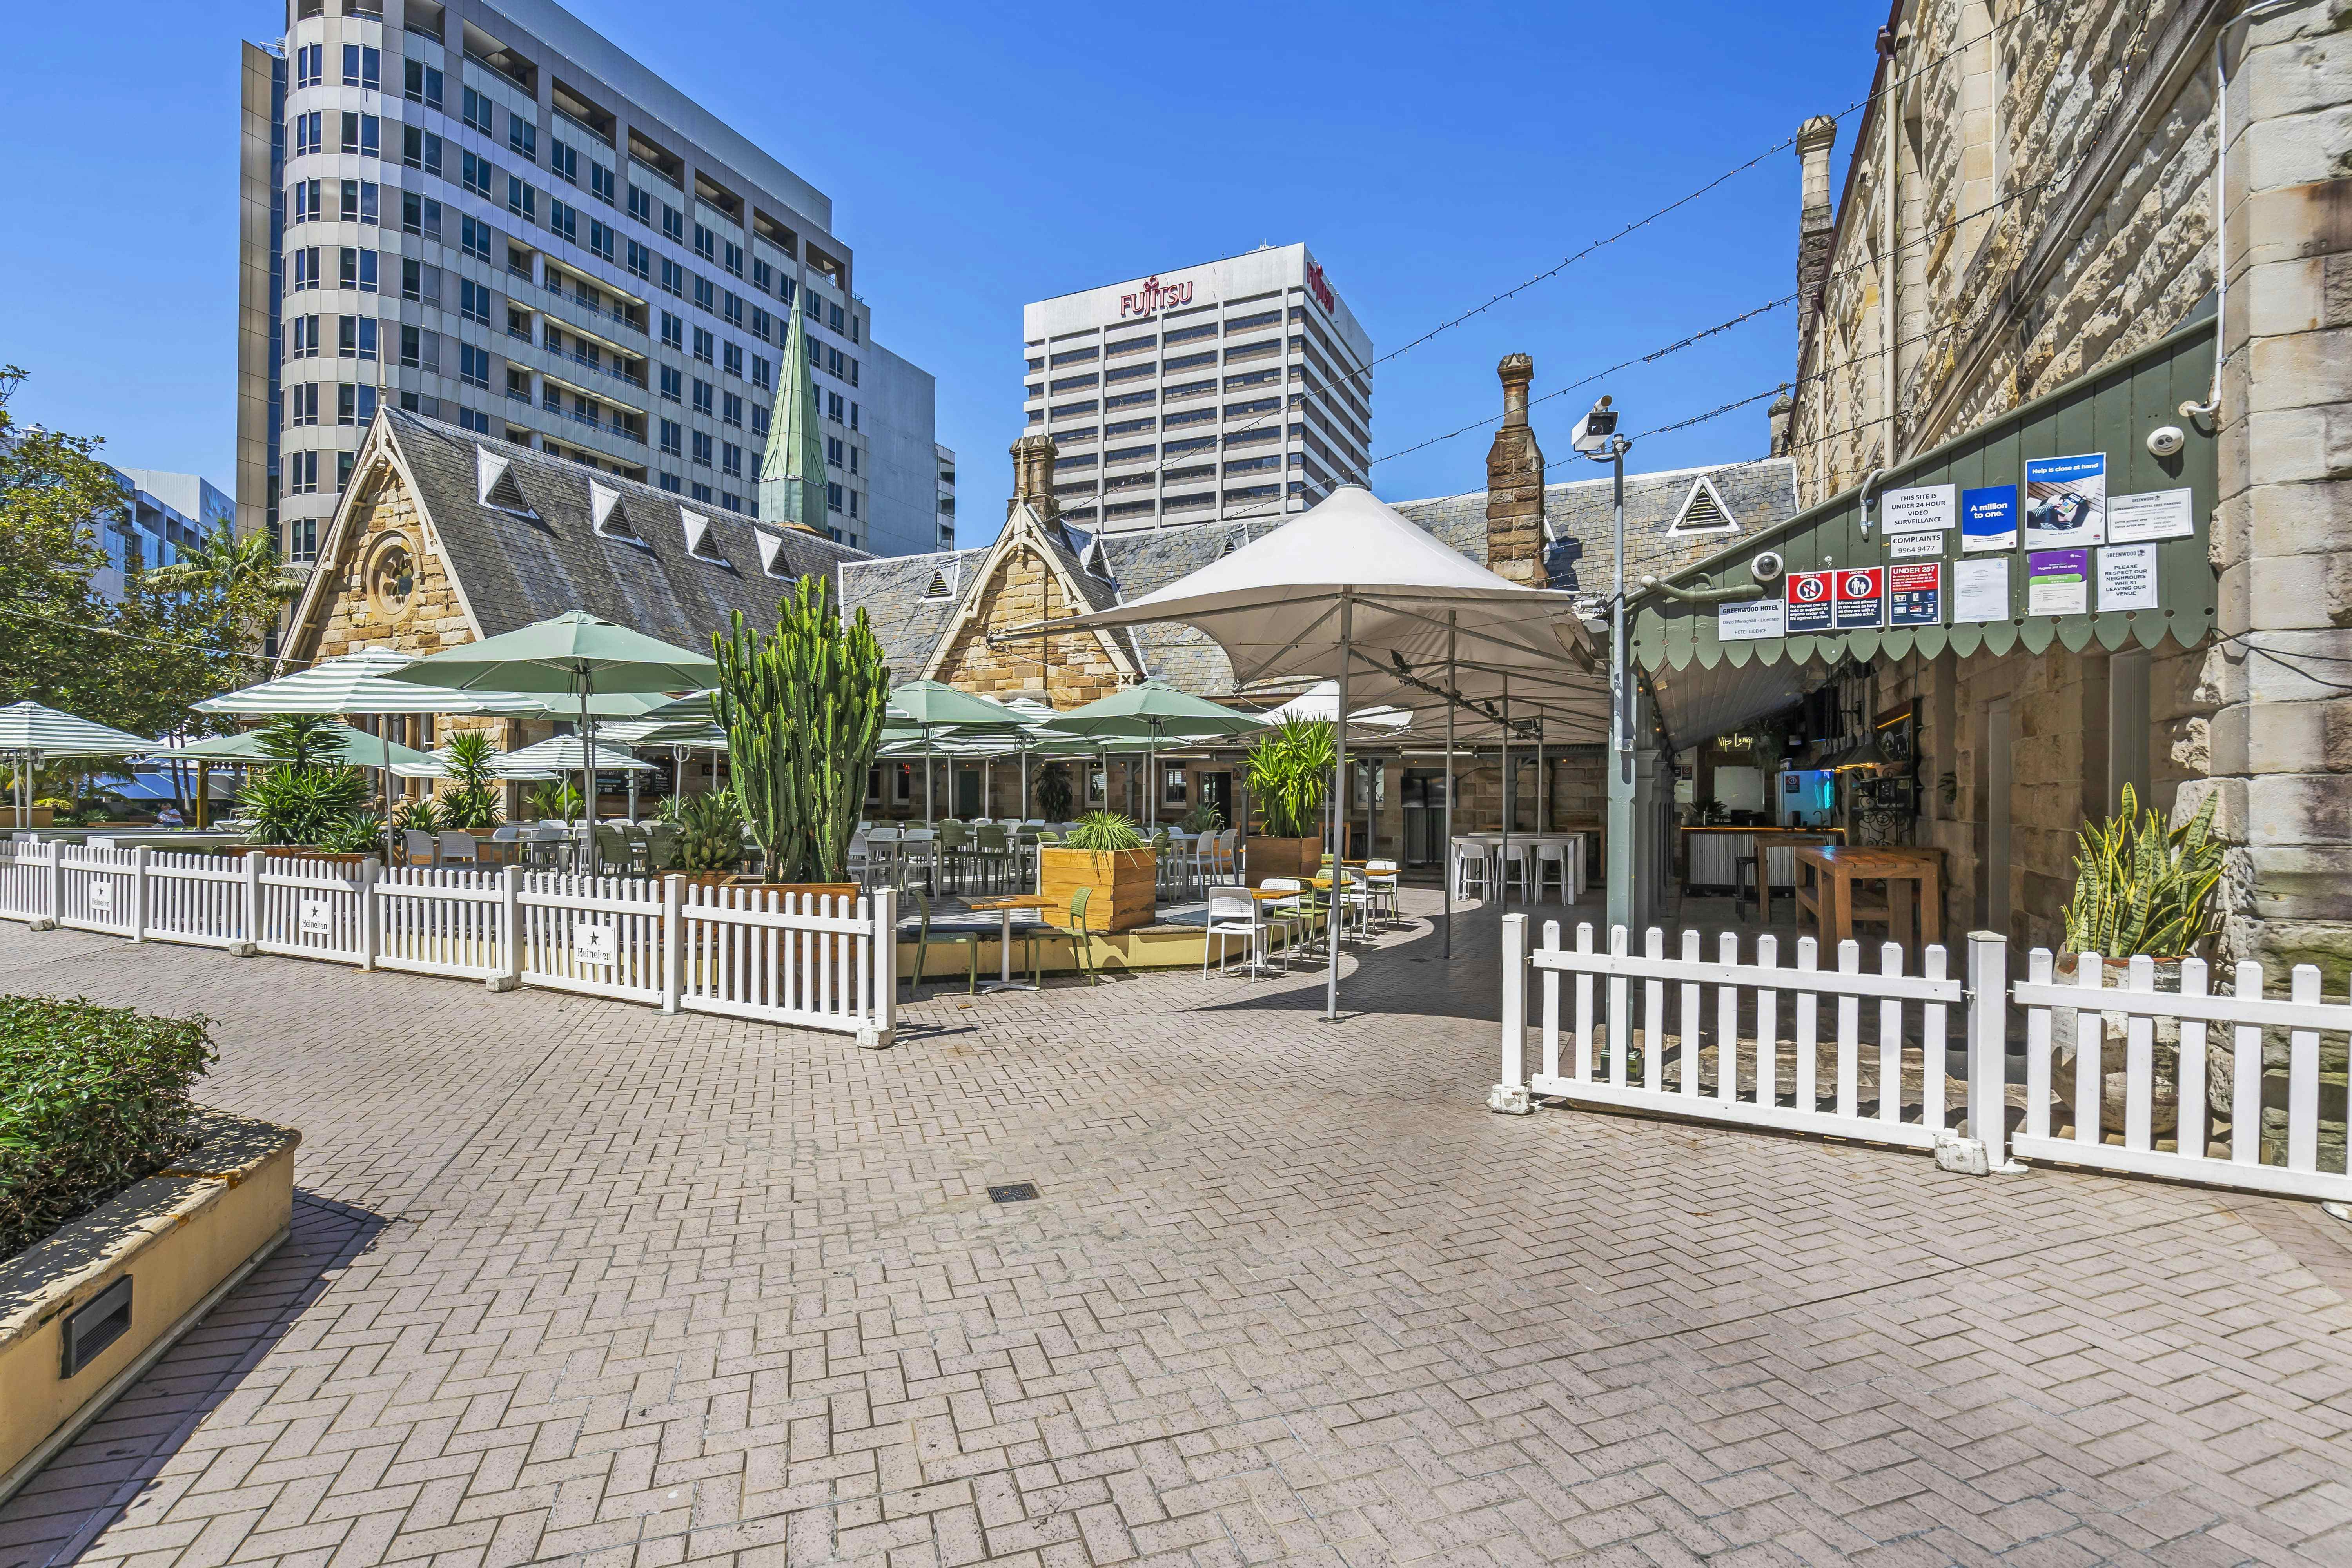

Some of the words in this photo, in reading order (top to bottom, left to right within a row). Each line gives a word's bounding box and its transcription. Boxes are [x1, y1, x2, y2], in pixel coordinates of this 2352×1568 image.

[1307, 262, 1334, 314] FUJITSU
[1120, 276, 1193, 317] FUJITSU
[1979, 503, 2008, 511] million
[1894, 517, 1942, 525] SURVEILLANCE
[1893, 535, 1940, 544] COMPLAINTS
[1718, 737, 1732, 752] Vip
[302, 919, 327, 930] Heineken
[577, 947, 612, 960] Heineken
